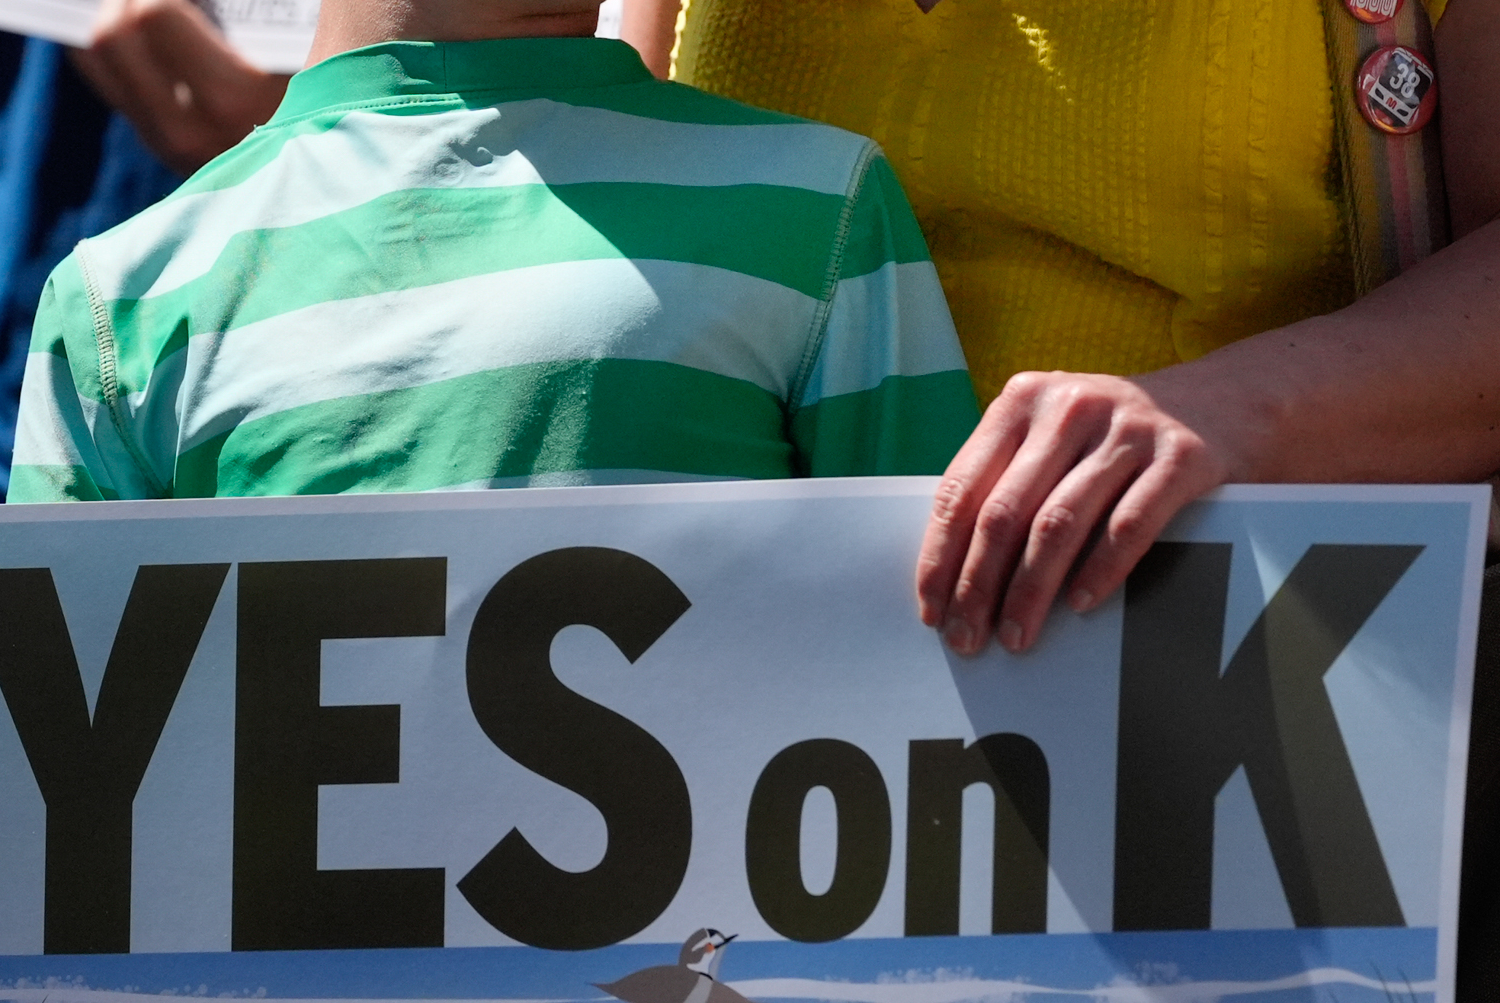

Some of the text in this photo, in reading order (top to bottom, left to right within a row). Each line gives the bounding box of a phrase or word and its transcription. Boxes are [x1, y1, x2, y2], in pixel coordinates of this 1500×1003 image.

[1389, 63, 1421, 98] 38
[744, 731, 1051, 944] on
[1112, 540, 1428, 933] K
